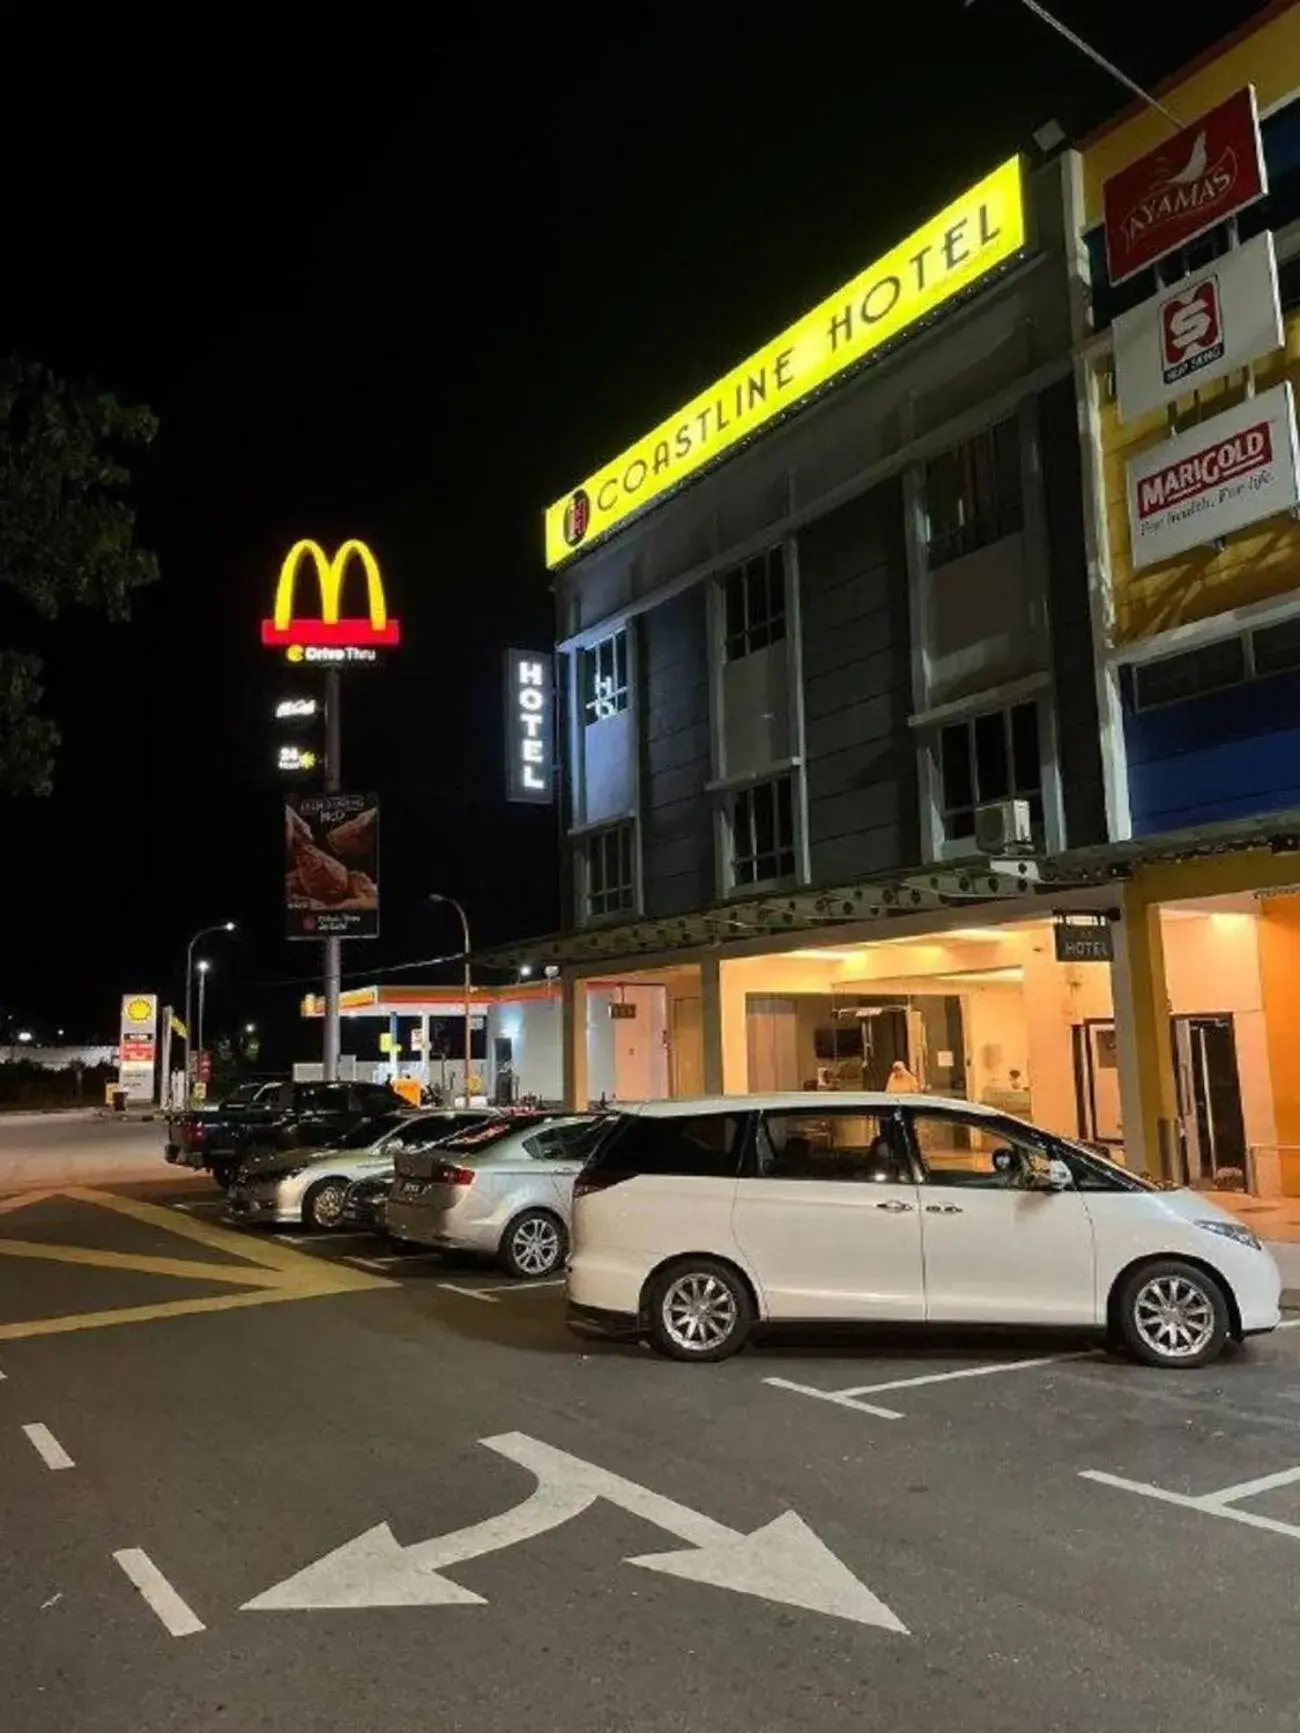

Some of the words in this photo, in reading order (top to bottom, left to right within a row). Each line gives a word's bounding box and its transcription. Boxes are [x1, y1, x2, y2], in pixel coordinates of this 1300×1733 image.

[1129, 170, 1230, 240] AYAMAS
[596, 346, 796, 513] COASTLINE
[827, 203, 1001, 353] HOTEL
[1140, 431, 1265, 513] MARIGOLD
[518, 660, 545, 790] HOTEL
[1064, 940, 1108, 956] HOTEL
